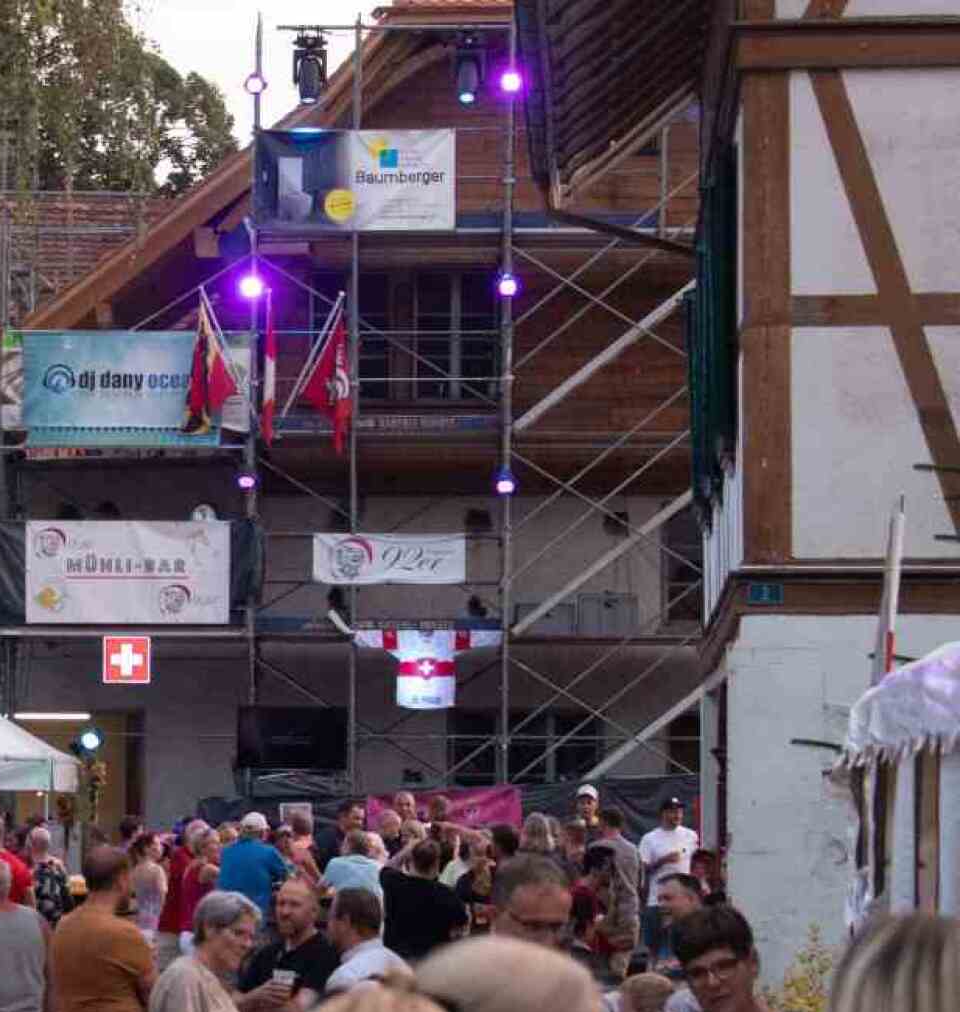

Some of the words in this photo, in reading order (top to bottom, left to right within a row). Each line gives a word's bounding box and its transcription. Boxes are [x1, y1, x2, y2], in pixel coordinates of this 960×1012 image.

[356, 170, 446, 185] Baumberger
[78, 371, 96, 391] dj
[100, 371, 144, 390] dany
[66, 552, 187, 574] MÜHLI-BAR
